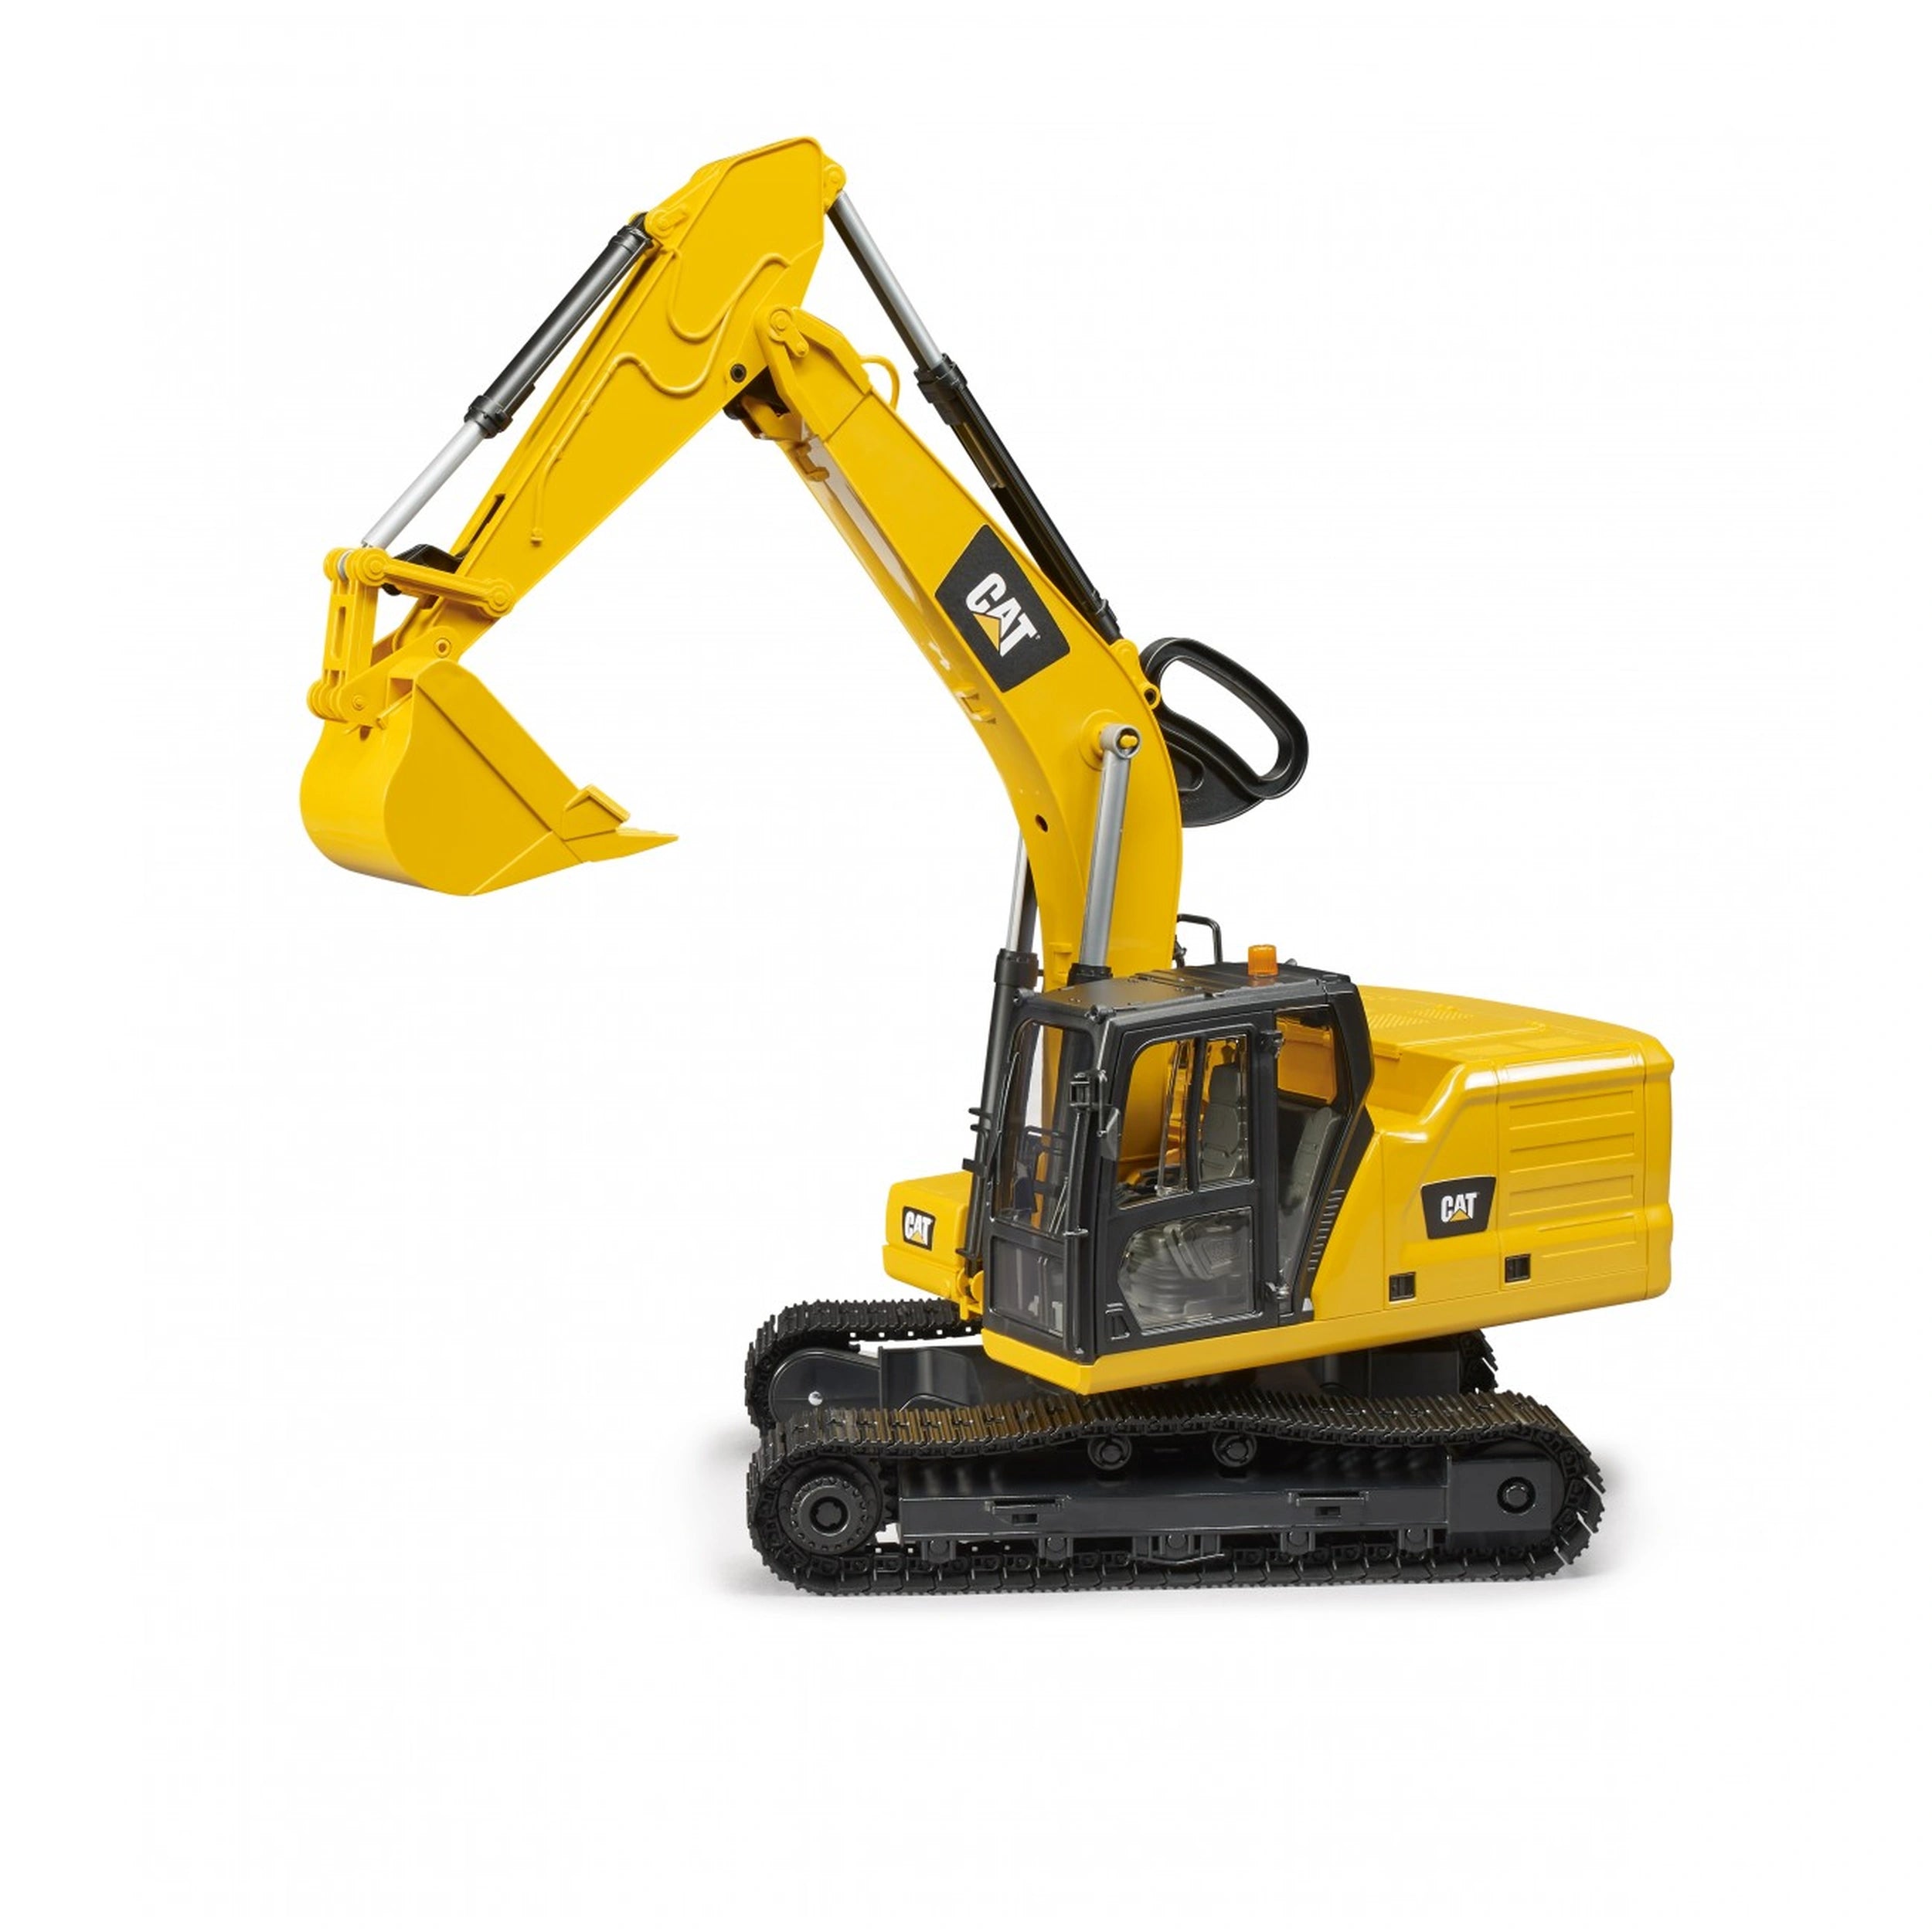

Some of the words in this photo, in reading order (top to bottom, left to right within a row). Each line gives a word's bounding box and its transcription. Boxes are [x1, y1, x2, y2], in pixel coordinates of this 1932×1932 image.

[966, 572, 1038, 657] CAT
[1440, 1192, 1478, 1223] CAT
[904, 1211, 933, 1246] CAT
